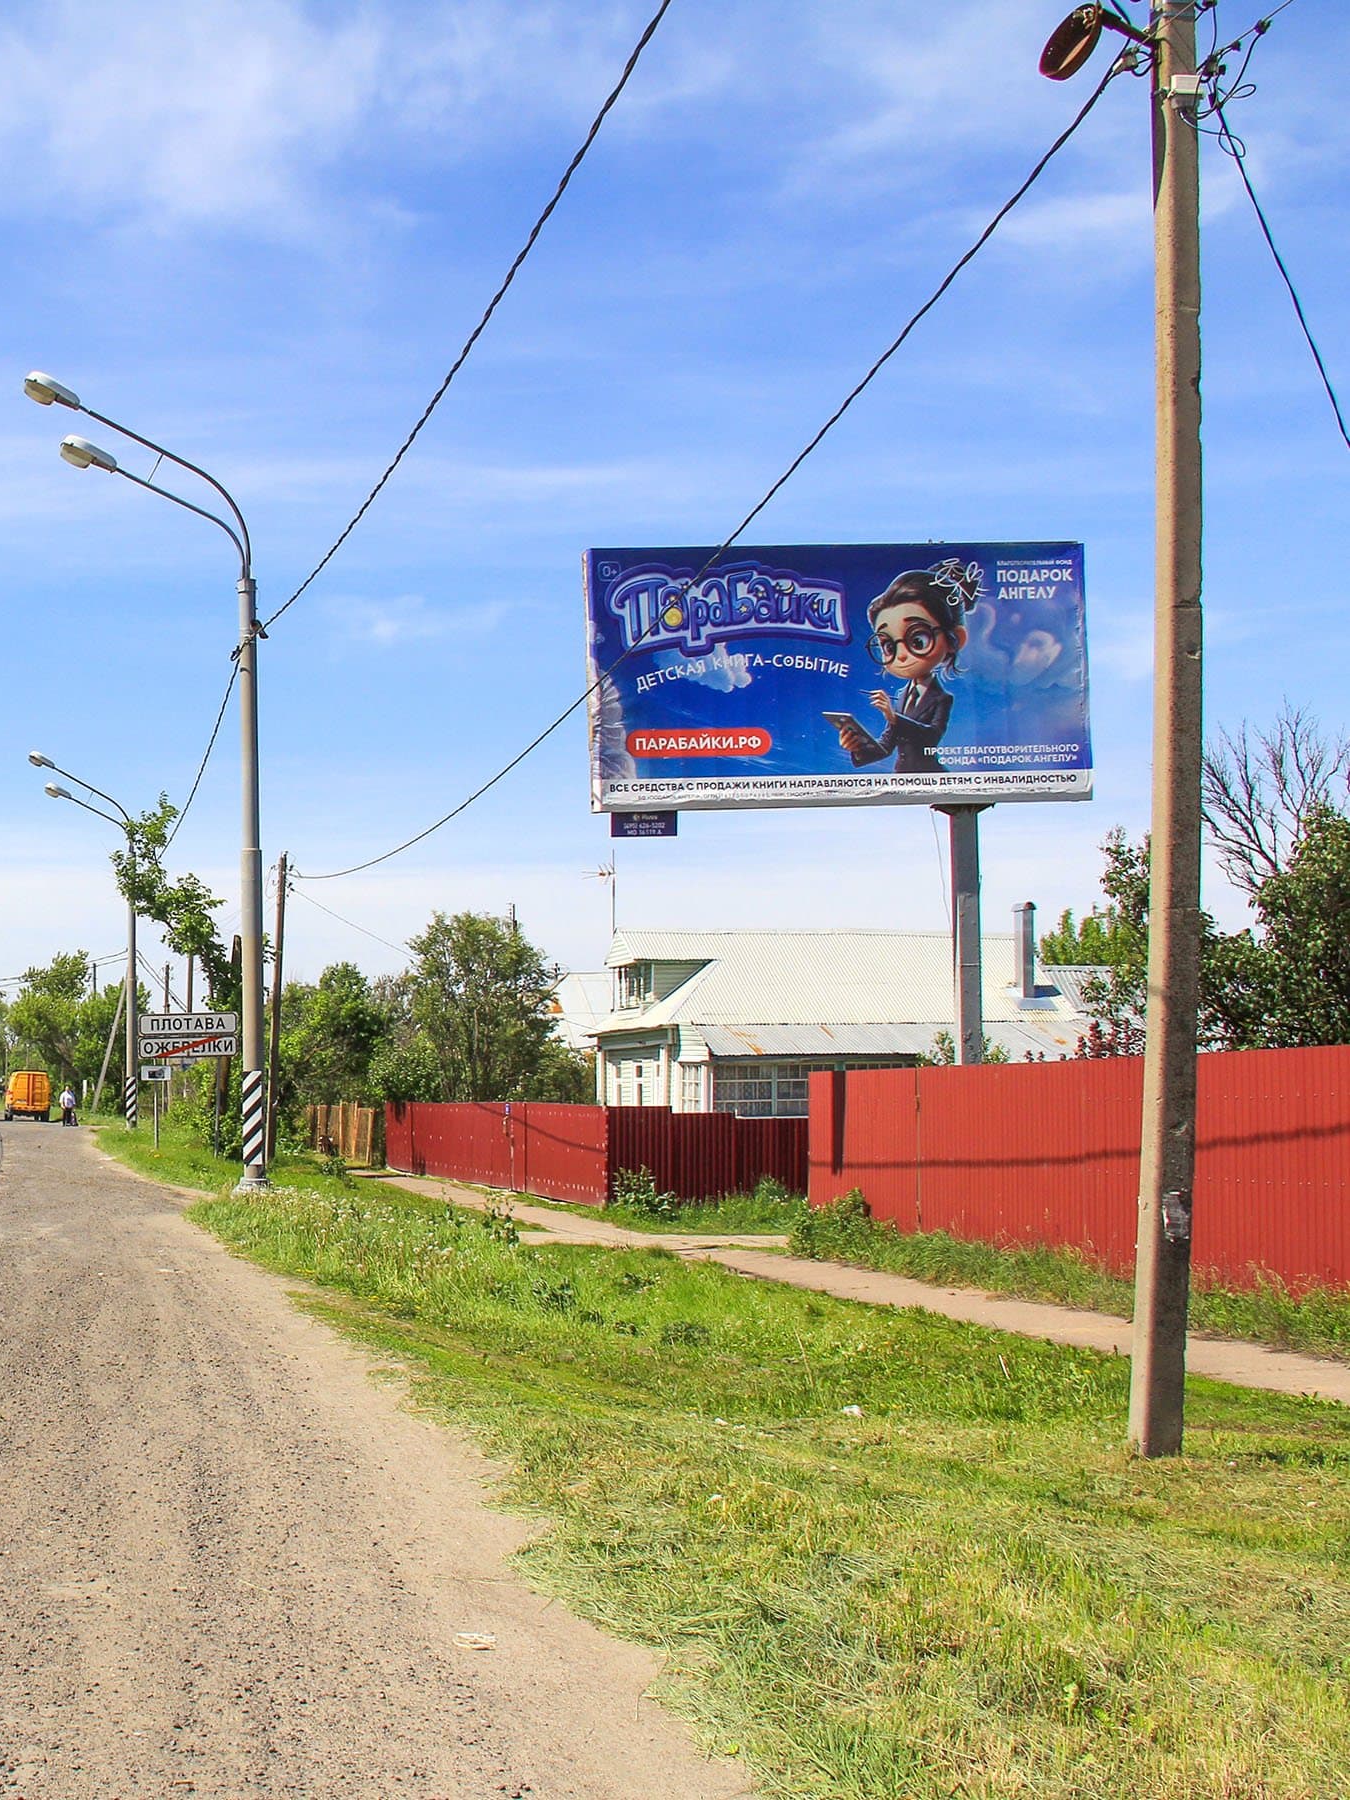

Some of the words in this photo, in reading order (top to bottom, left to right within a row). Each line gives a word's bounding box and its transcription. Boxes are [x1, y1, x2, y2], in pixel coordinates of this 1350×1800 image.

[602, 566, 618, 577] 0+
[996, 568, 1074, 584] ПОДАРОК
[996, 585, 1057, 600] АНГЕЛУ
[635, 660, 706, 694] ДЕТСКАЯ
[713, 653, 850, 678] КНИГА-СОБЫТИЕ
[635, 733, 763, 751] ПАРАБАЙКИ.РФ
[923, 745, 962, 756] ПРОЕКТ
[963, 743, 1079, 755] БЛАГОТВОРИТЕЛЬНОГО
[937, 756, 977, 766] ФОНДА
[609, 783, 629, 793] ВСЕ
[631, 782, 685, 793] СРЕДСТВА
[686, 781, 695, 791] С
[696, 781, 750, 792] ПРОДАЖИ
[752, 780, 788, 790] КНИГИ
[789, 777, 873, 789] НАПРАВЛЯЮТСЯ
[874, 777, 889, 787] НА
[890, 777, 938, 787] ПОМОЩЬ
[939, 776, 974, 786] ДЕТЯМ
[975, 775, 983, 785] С
[983, 774, 1077, 785] ИНВАЛИДНОСТЬЮ
[151, 1017, 226, 1031] ПЛОТАВА
